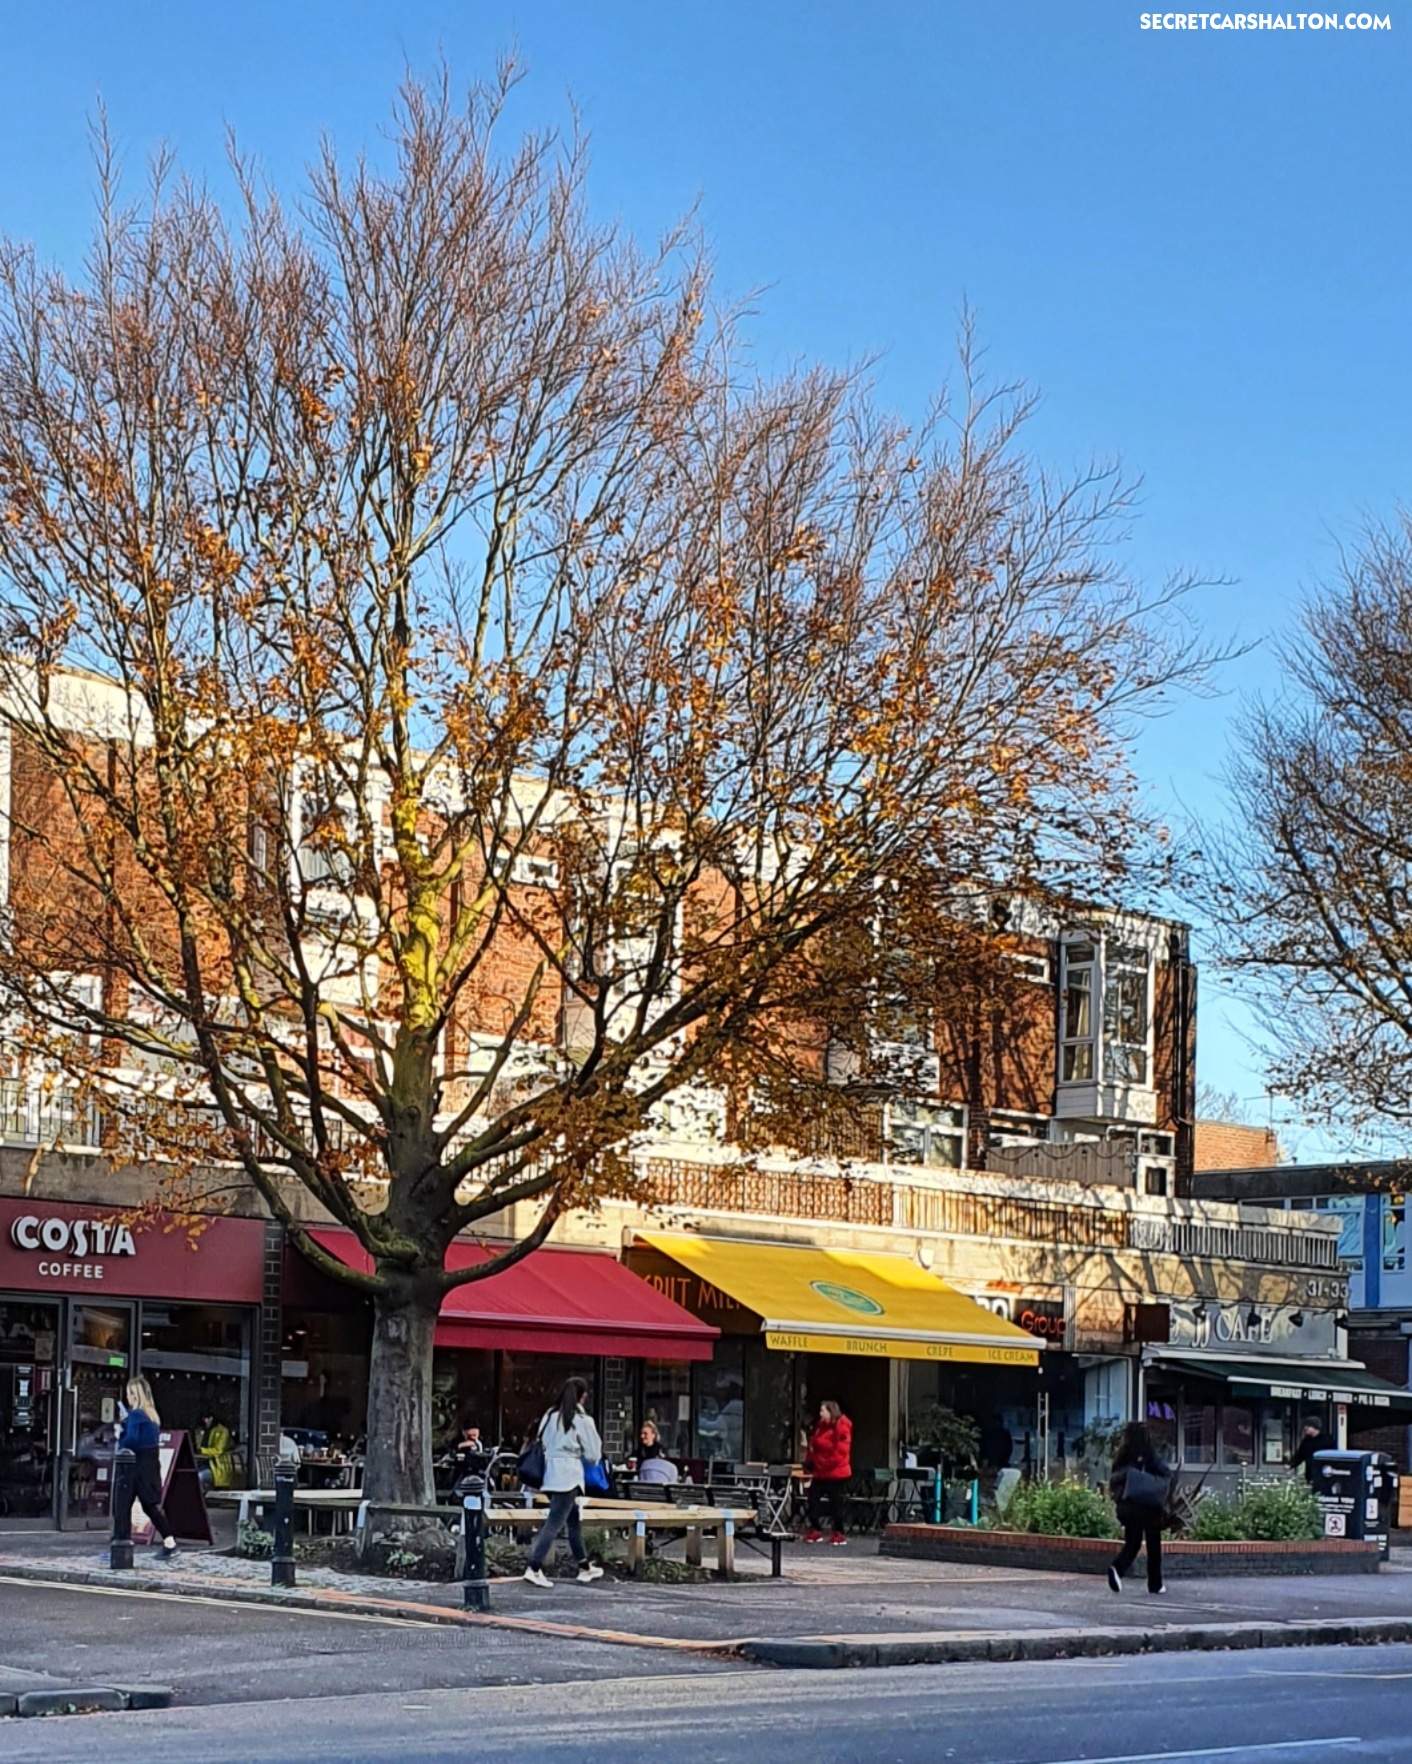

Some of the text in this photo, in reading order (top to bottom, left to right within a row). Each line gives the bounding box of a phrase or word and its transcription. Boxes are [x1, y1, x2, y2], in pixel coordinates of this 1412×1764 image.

[11, 1215, 136, 1257] COSTA
[38, 1261, 104, 1279] COFFEE
[697, 1281, 740, 1310] MIL
[1021, 1310, 1067, 1337] Group
[769, 1335, 808, 1348] WAFFLE
[846, 1340, 888, 1353] BRUNCH
[988, 1349, 1001, 1360] ICE
[1004, 1350, 1035, 1362] CREAM
